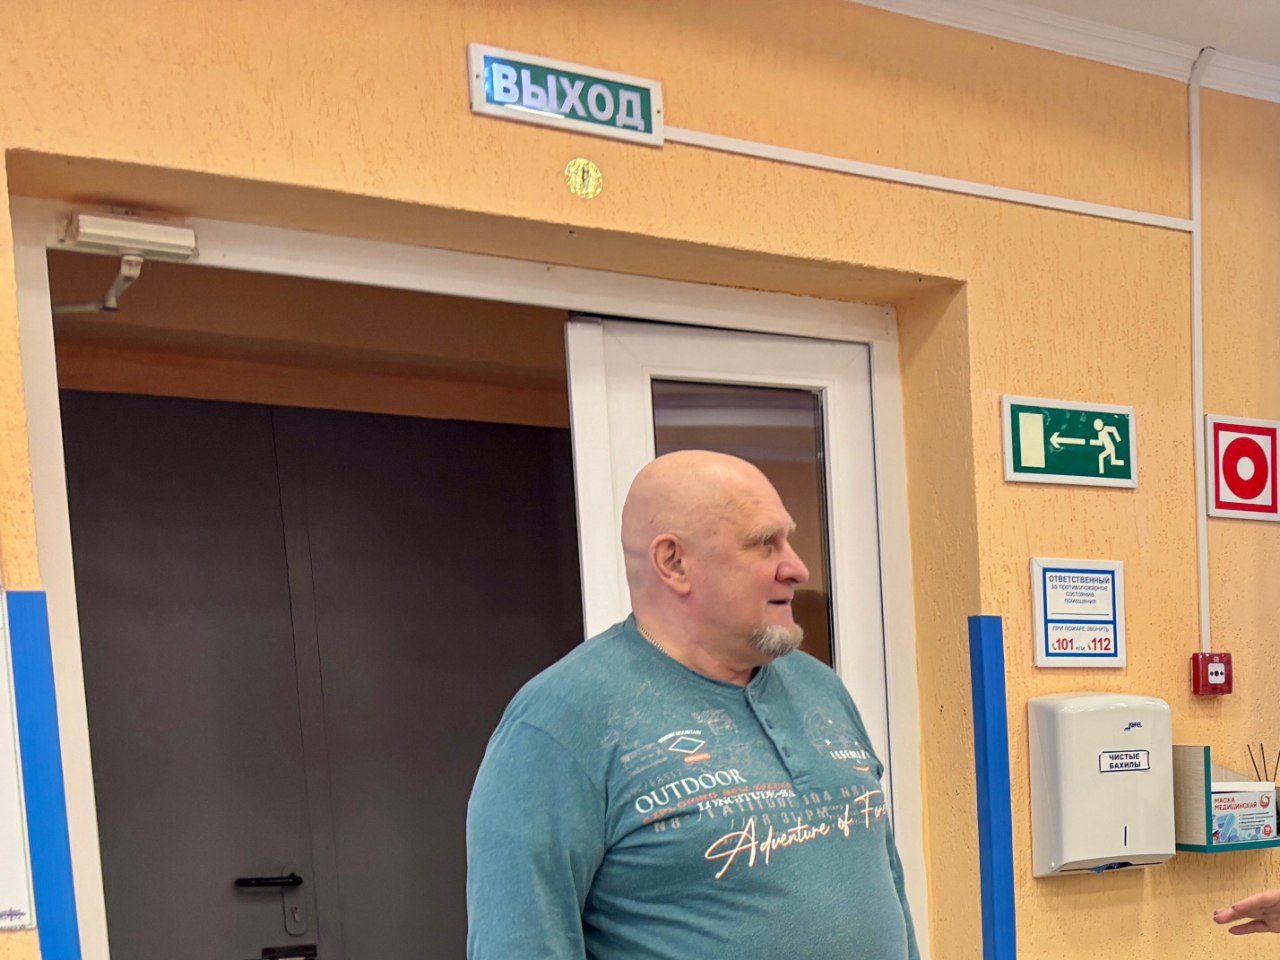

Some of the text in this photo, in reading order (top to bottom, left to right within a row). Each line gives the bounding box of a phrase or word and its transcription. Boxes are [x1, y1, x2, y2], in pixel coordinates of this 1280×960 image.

[492, 62, 645, 132] ВЫХОД
[1048, 575, 1110, 584] ОТВЕТСТВЕННЫЙ
[1059, 584, 1108, 592] противопожарное
[1086, 625, 1110, 633] ЗВОНИТЬ
[1055, 637, 1074, 651] 101
[1091, 637, 1112, 651] 112
[1108, 753, 1140, 761] ЧИСТЫЕ
[1109, 761, 1141, 769] БАХИЛЫ
[634, 768, 748, 814] OUTDOOR
[1214, 802, 1258, 811] МЕДИЦИНСКАЯ
[704, 815, 830, 881] Adventure
[837, 803, 854, 838] of
